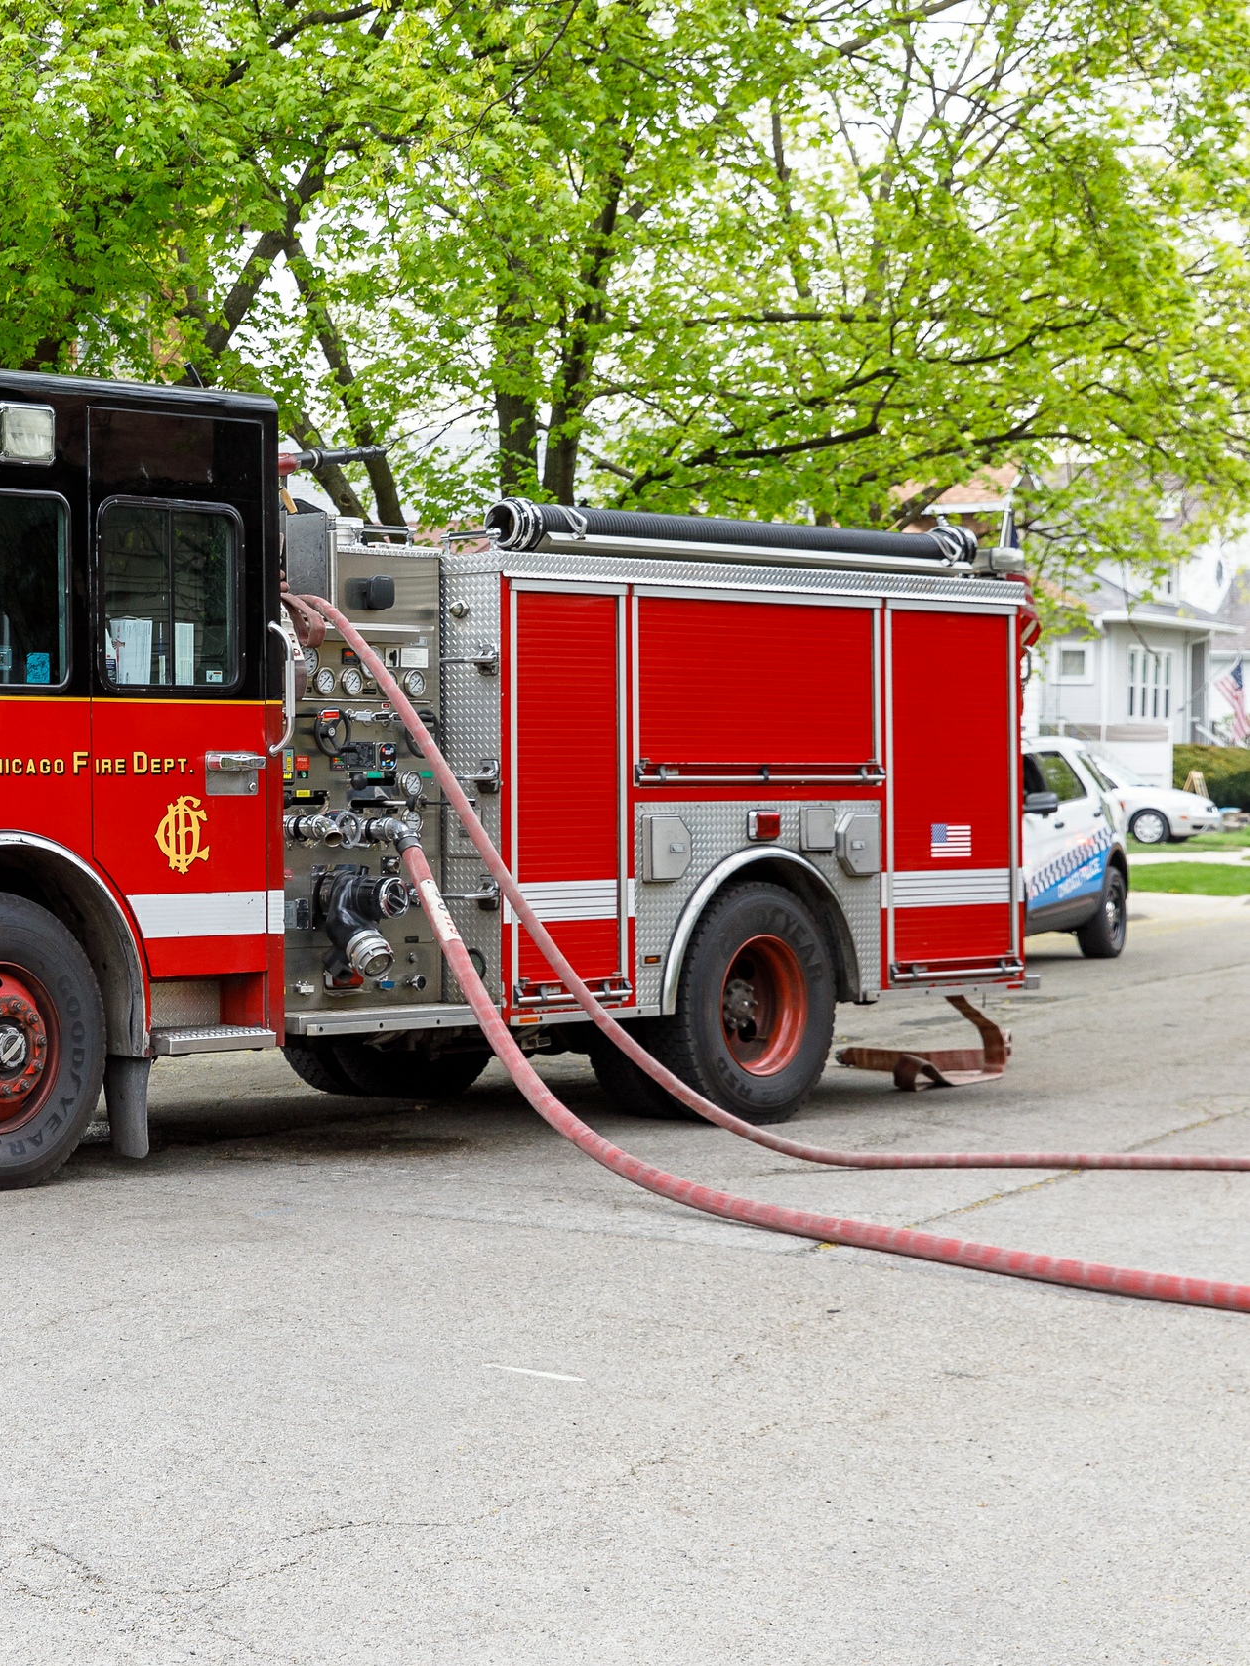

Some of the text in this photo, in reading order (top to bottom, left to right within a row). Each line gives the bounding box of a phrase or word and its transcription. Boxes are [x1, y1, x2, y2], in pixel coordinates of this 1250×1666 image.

[72, 750, 126, 776] FIRE
[133, 750, 194, 776] DEPT.
[719, 906, 824, 985] GDYEAR
[9, 973, 86, 1157] GOODYEAR
